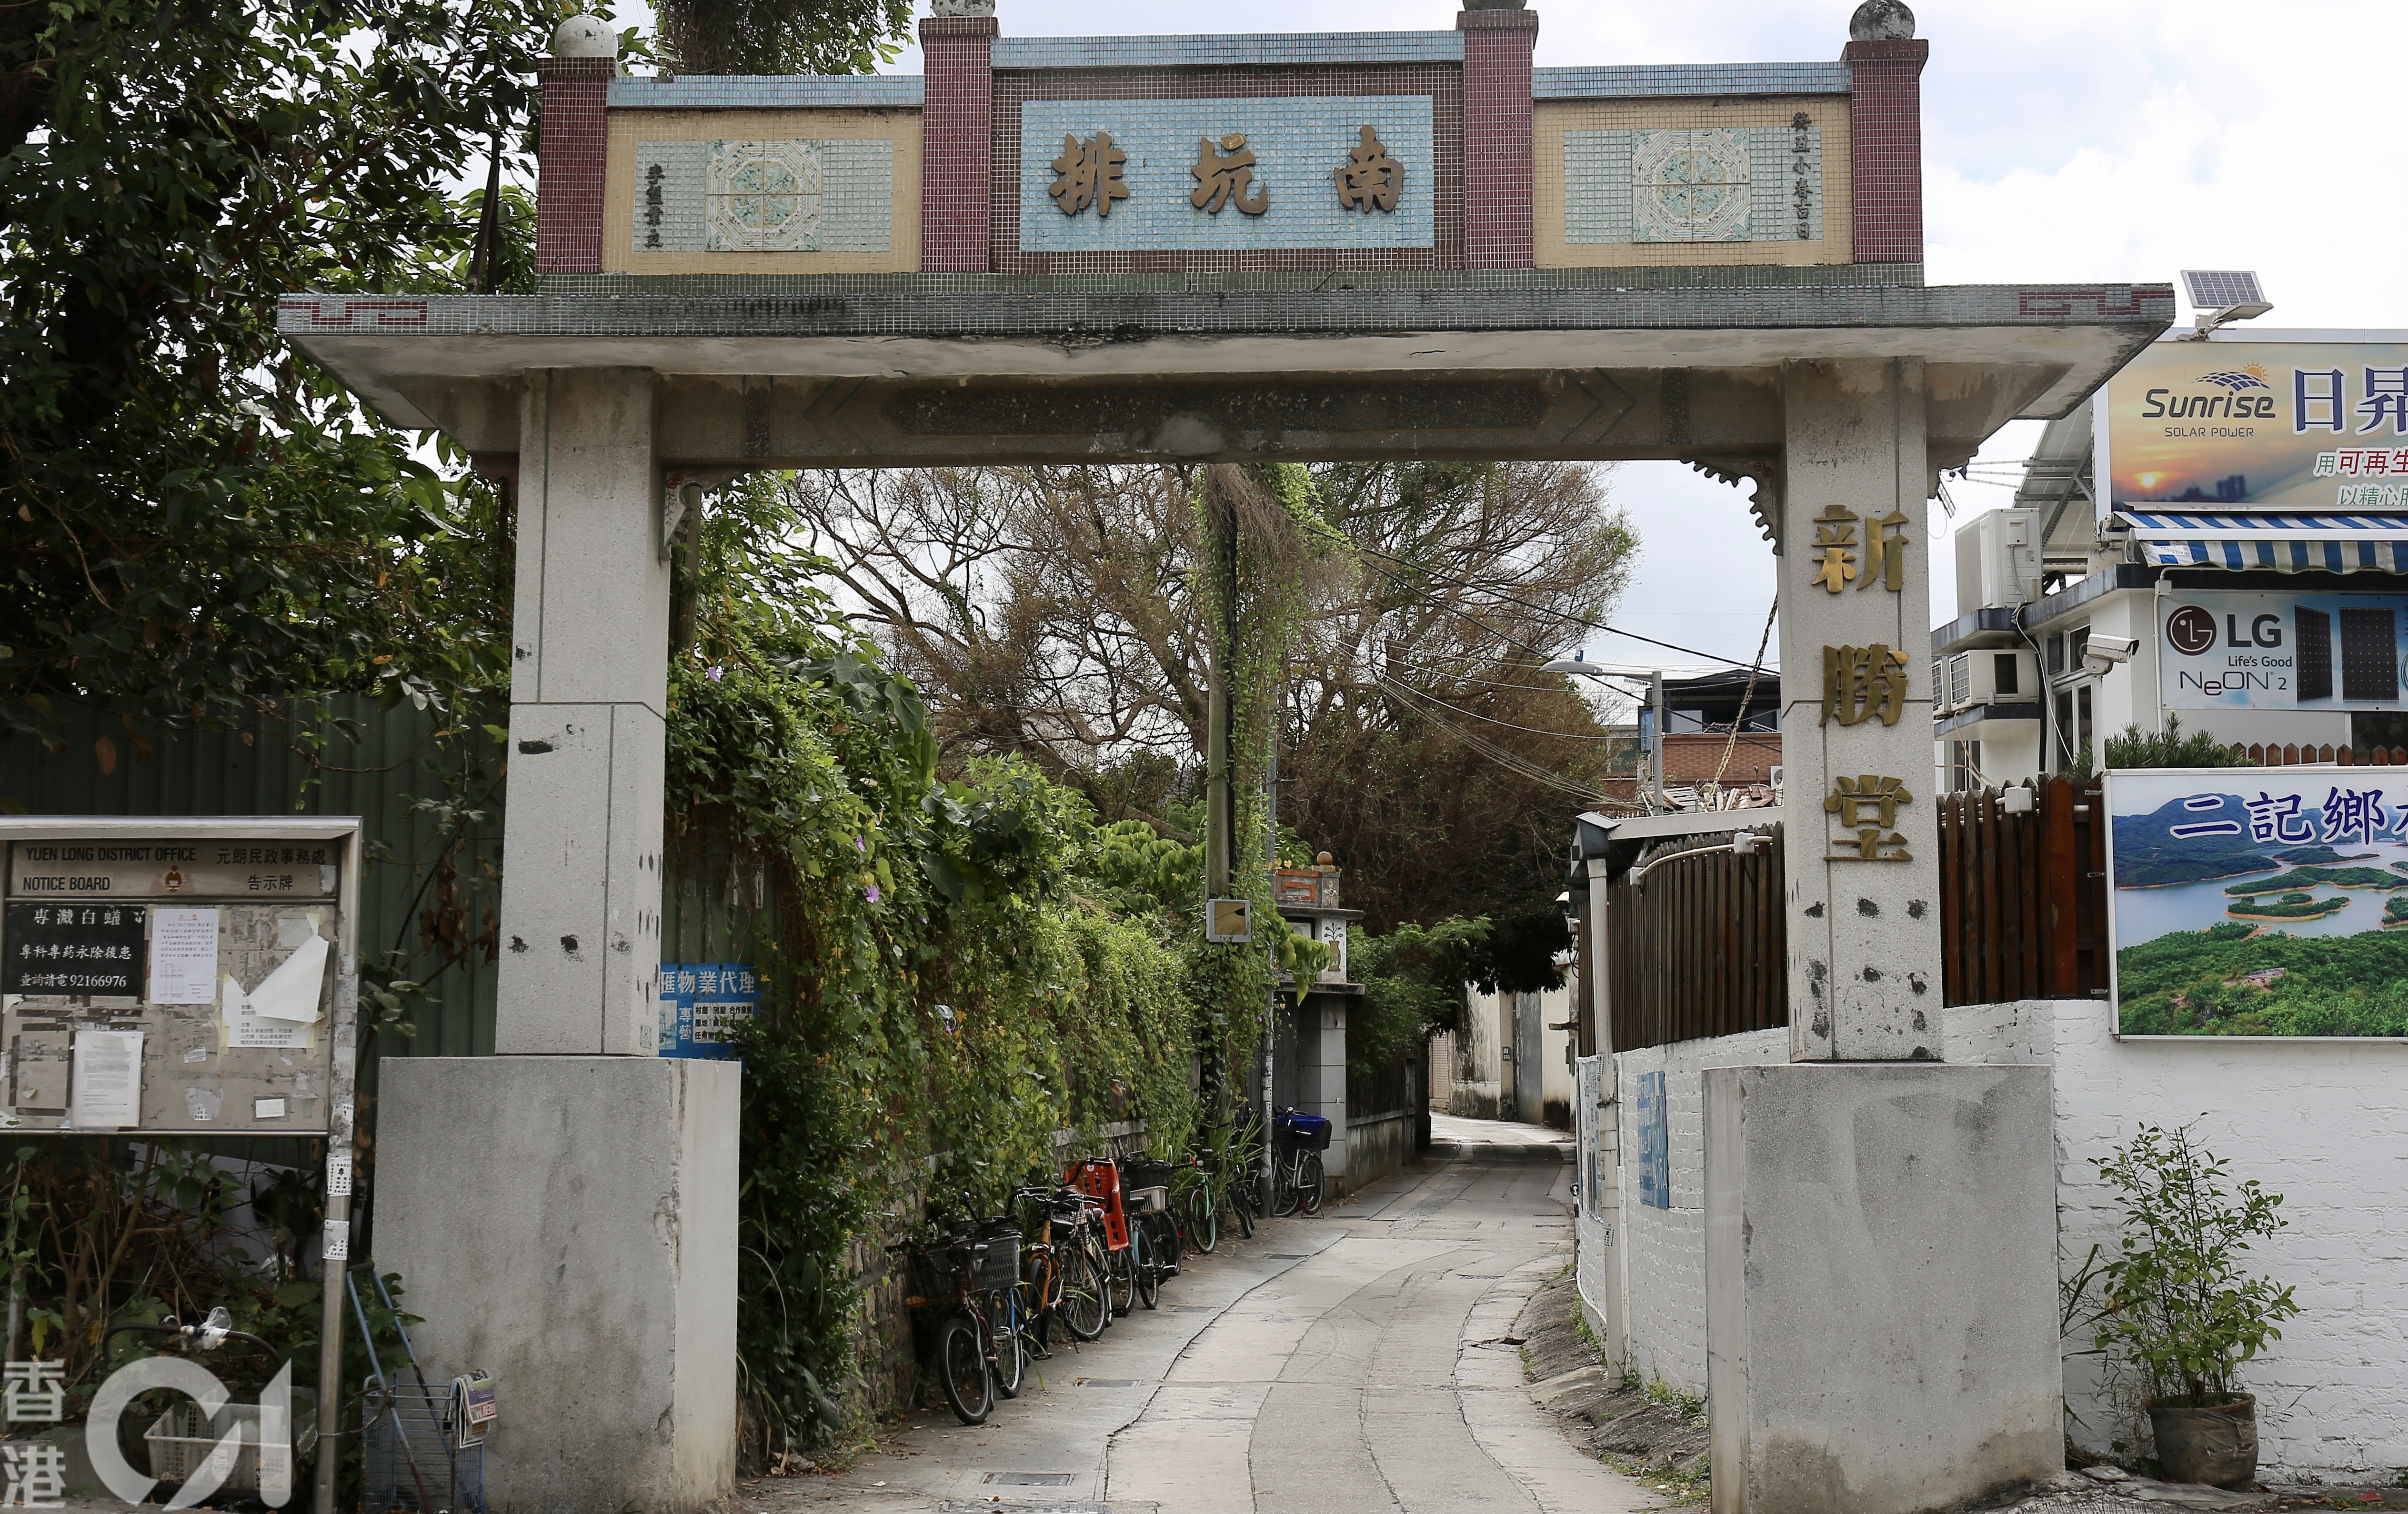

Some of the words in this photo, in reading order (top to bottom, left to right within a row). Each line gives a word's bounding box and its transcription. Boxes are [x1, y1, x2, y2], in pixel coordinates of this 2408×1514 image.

[2142, 389, 2276, 418] Sunrise
[2165, 427, 2206, 437] SOLAR
[2211, 427, 2254, 437] POWER
[2227, 613, 2282, 648] LG
[2228, 656, 2258, 667] Life's
[2261, 656, 2292, 667] Good
[1811, 504, 1914, 861] 新勝堂
[2278, 677, 2287, 690] 2
[2171, 786, 2408, 845] 二記鄉
[26, 847, 57, 861] YUEN
[61, 847, 94, 861] LONG
[98, 847, 151, 861] DISTRICT
[155, 847, 196, 861] OFFICE
[217, 848, 326, 865] 元朗民政事務處
[23, 877, 65, 891] NOTICE
[70, 877, 110, 891] BOARD
[248, 875, 293, 891] 告示牌
[33, 908, 121, 925] 專滅白蟻
[70, 975, 127, 987] 92166976
